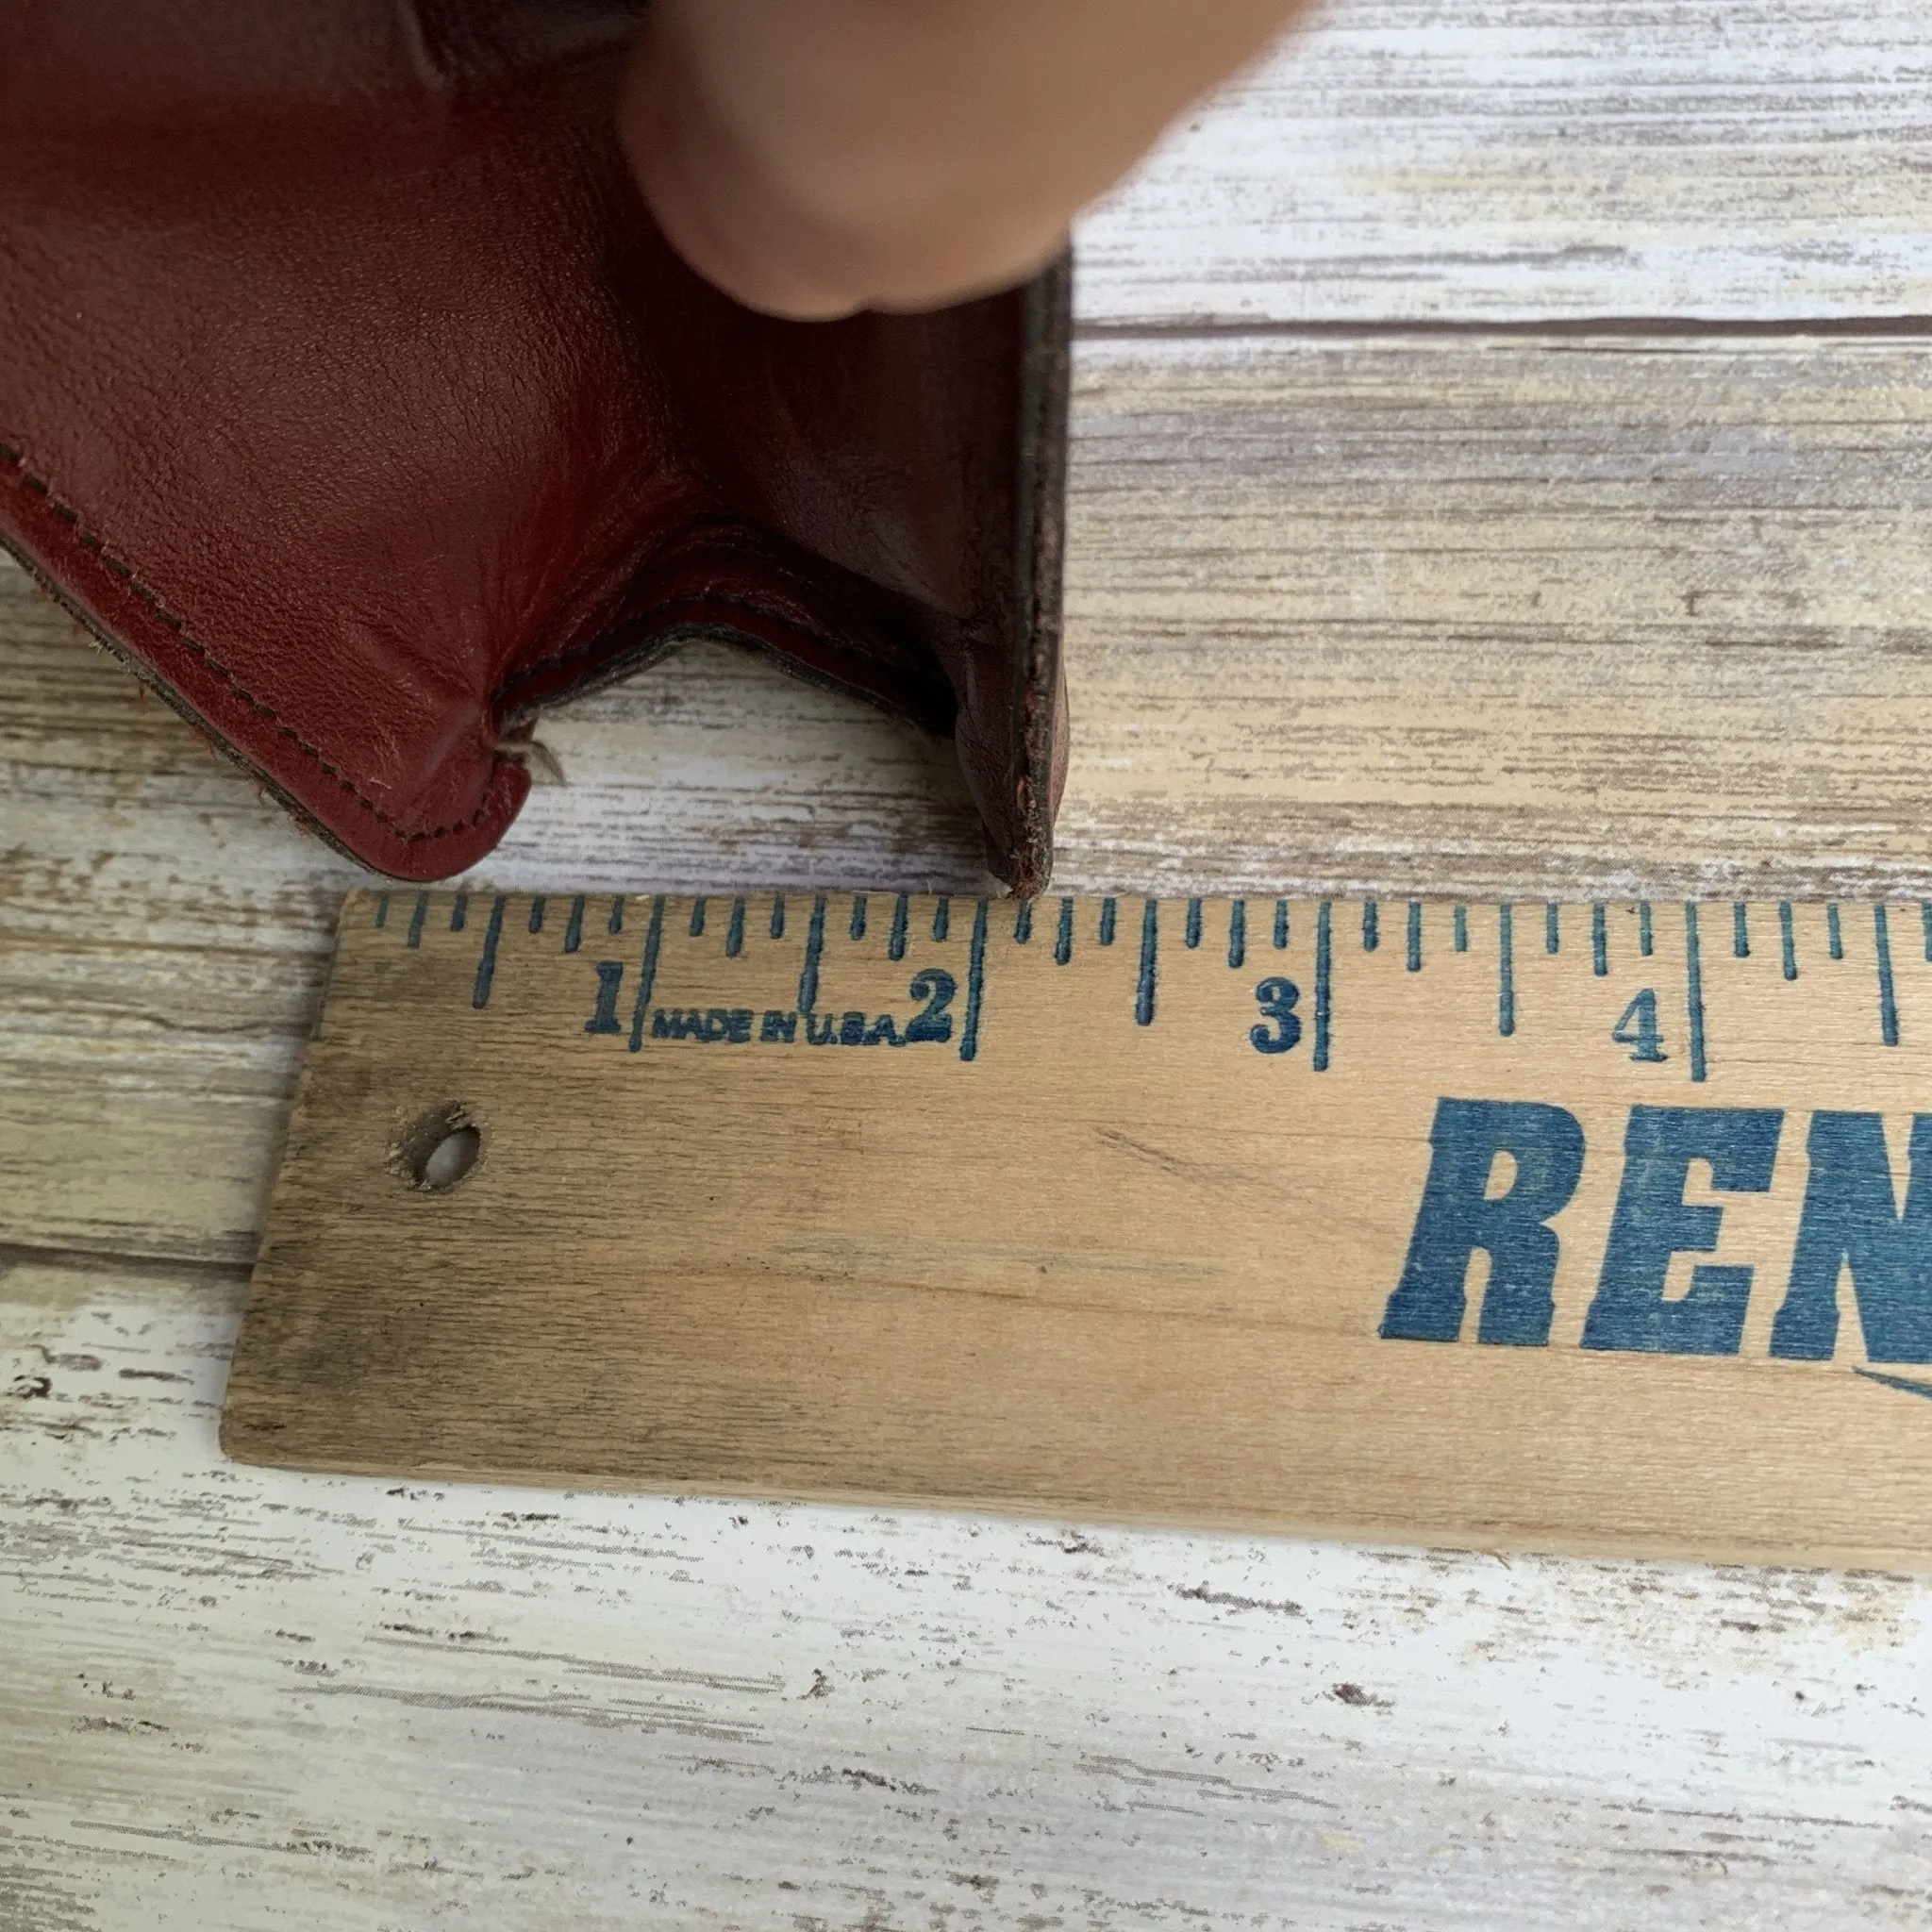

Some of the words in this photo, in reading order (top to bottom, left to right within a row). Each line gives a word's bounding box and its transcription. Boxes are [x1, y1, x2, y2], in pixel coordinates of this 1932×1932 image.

[584, 959, 624, 1035] 1
[651, 1008, 754, 1043] MADE
[760, 1009, 800, 1043] IN
[905, 968, 958, 1043] 2
[1249, 976, 1302, 1055] 3
[1611, 987, 1669, 1063] 4
